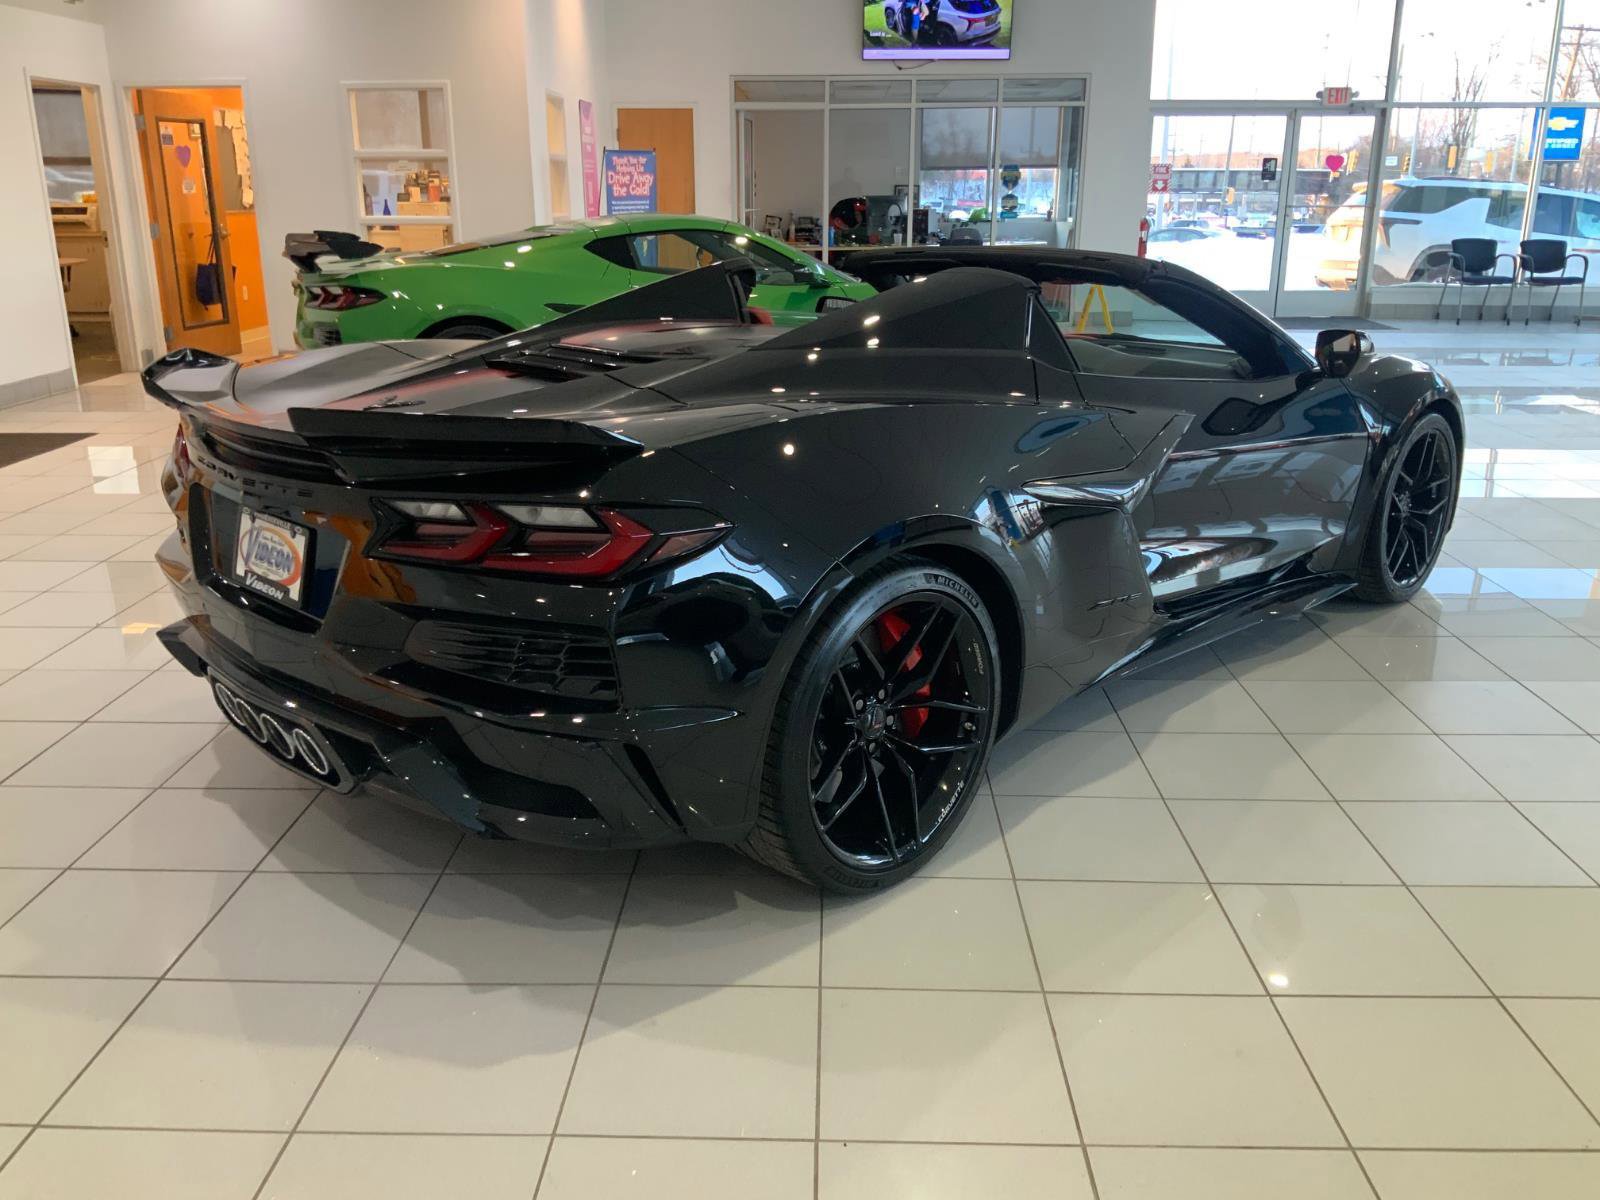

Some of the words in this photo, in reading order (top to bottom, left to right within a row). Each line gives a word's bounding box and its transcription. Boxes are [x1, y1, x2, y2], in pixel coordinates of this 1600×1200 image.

[1327, 87, 1349, 104] EXIT
[608, 171, 630, 184] Drive
[632, 172, 654, 187] Away
[613, 183, 627, 196] the
[198, 456, 313, 498] CORVETTE
[937, 575, 979, 607] MICHELIN
[938, 780, 965, 822] CORVETTE
